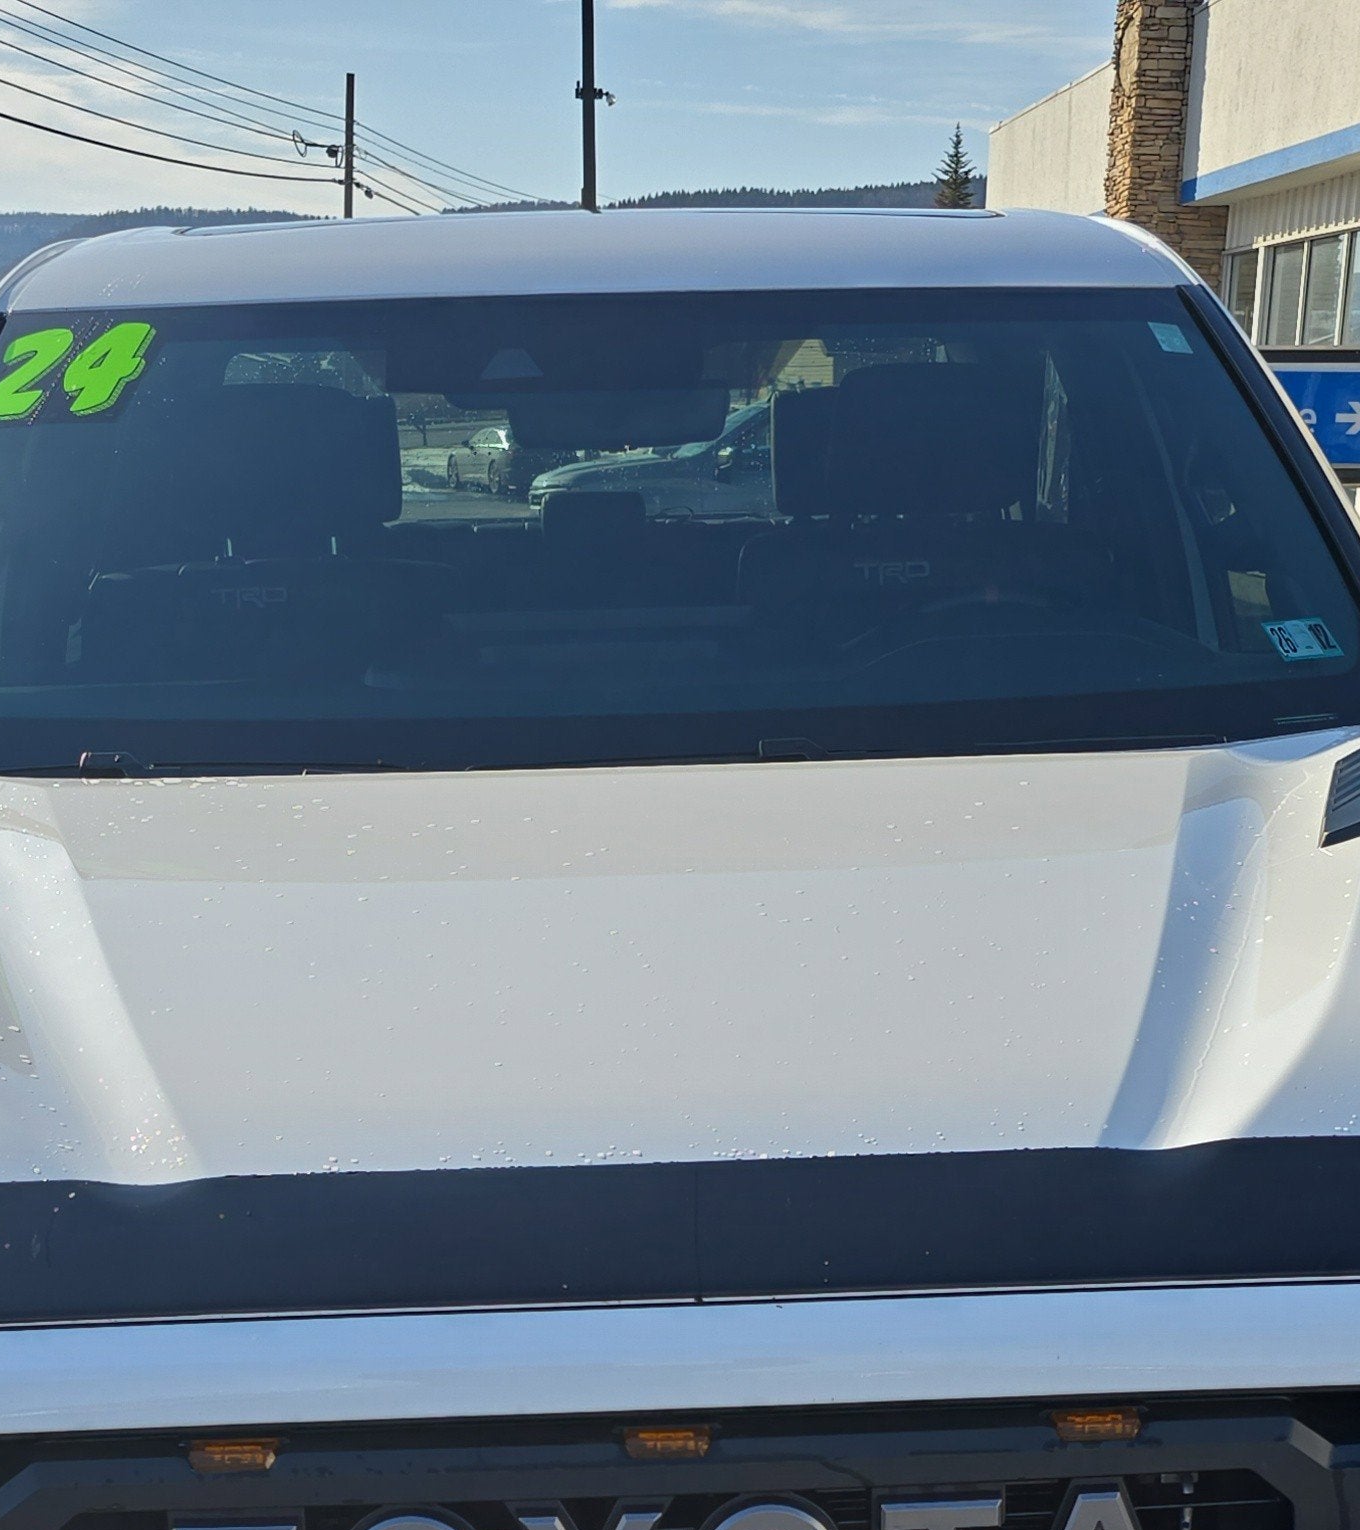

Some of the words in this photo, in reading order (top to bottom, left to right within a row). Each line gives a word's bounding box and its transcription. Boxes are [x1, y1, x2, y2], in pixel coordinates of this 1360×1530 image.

[853, 560, 930, 586] TRD
[1269, 626, 1298, 654] 26
[1308, 623, 1337, 650] 12
